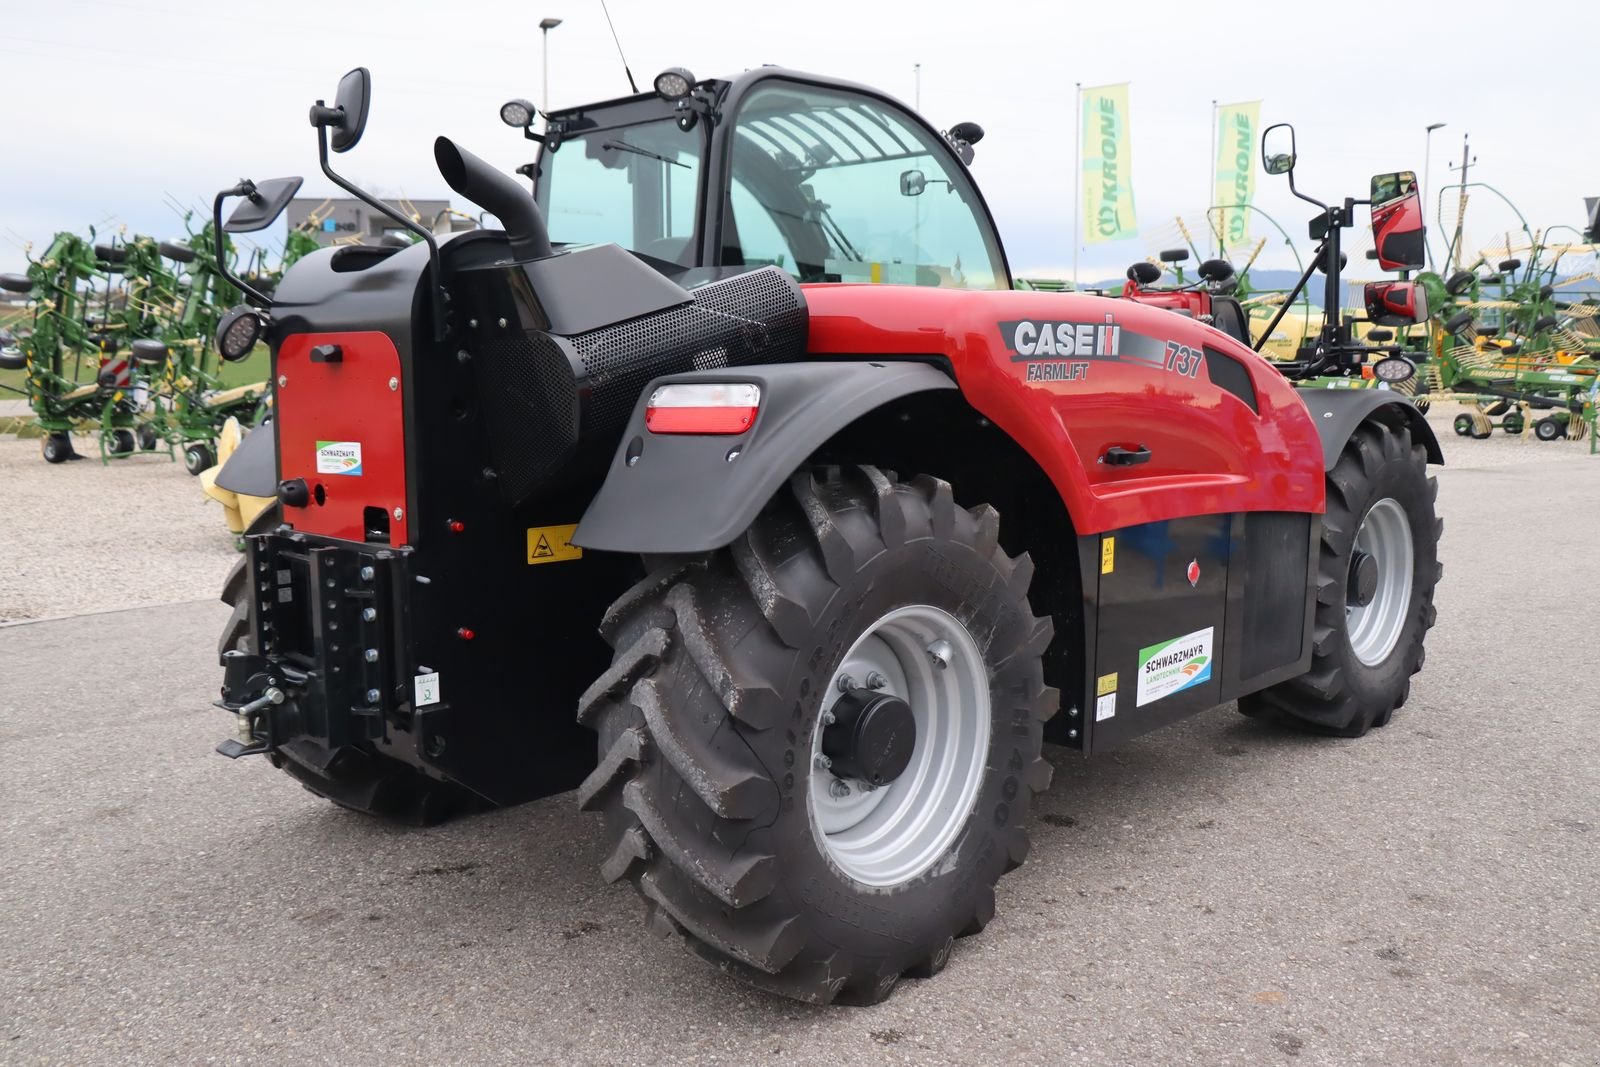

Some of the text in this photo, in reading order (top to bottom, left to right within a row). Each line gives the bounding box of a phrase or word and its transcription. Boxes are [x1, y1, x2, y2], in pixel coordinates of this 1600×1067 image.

[1100, 97, 1117, 202] KRONE
[1235, 113, 1250, 212] KRONE
[1014, 321, 1094, 356] CASE
[1026, 362, 1089, 382] FARMLIFT
[1166, 340, 1203, 379] 737
[1145, 644, 1204, 674] SCHWARZMAYR
[1146, 667, 1181, 685] LANDTECHNIK
